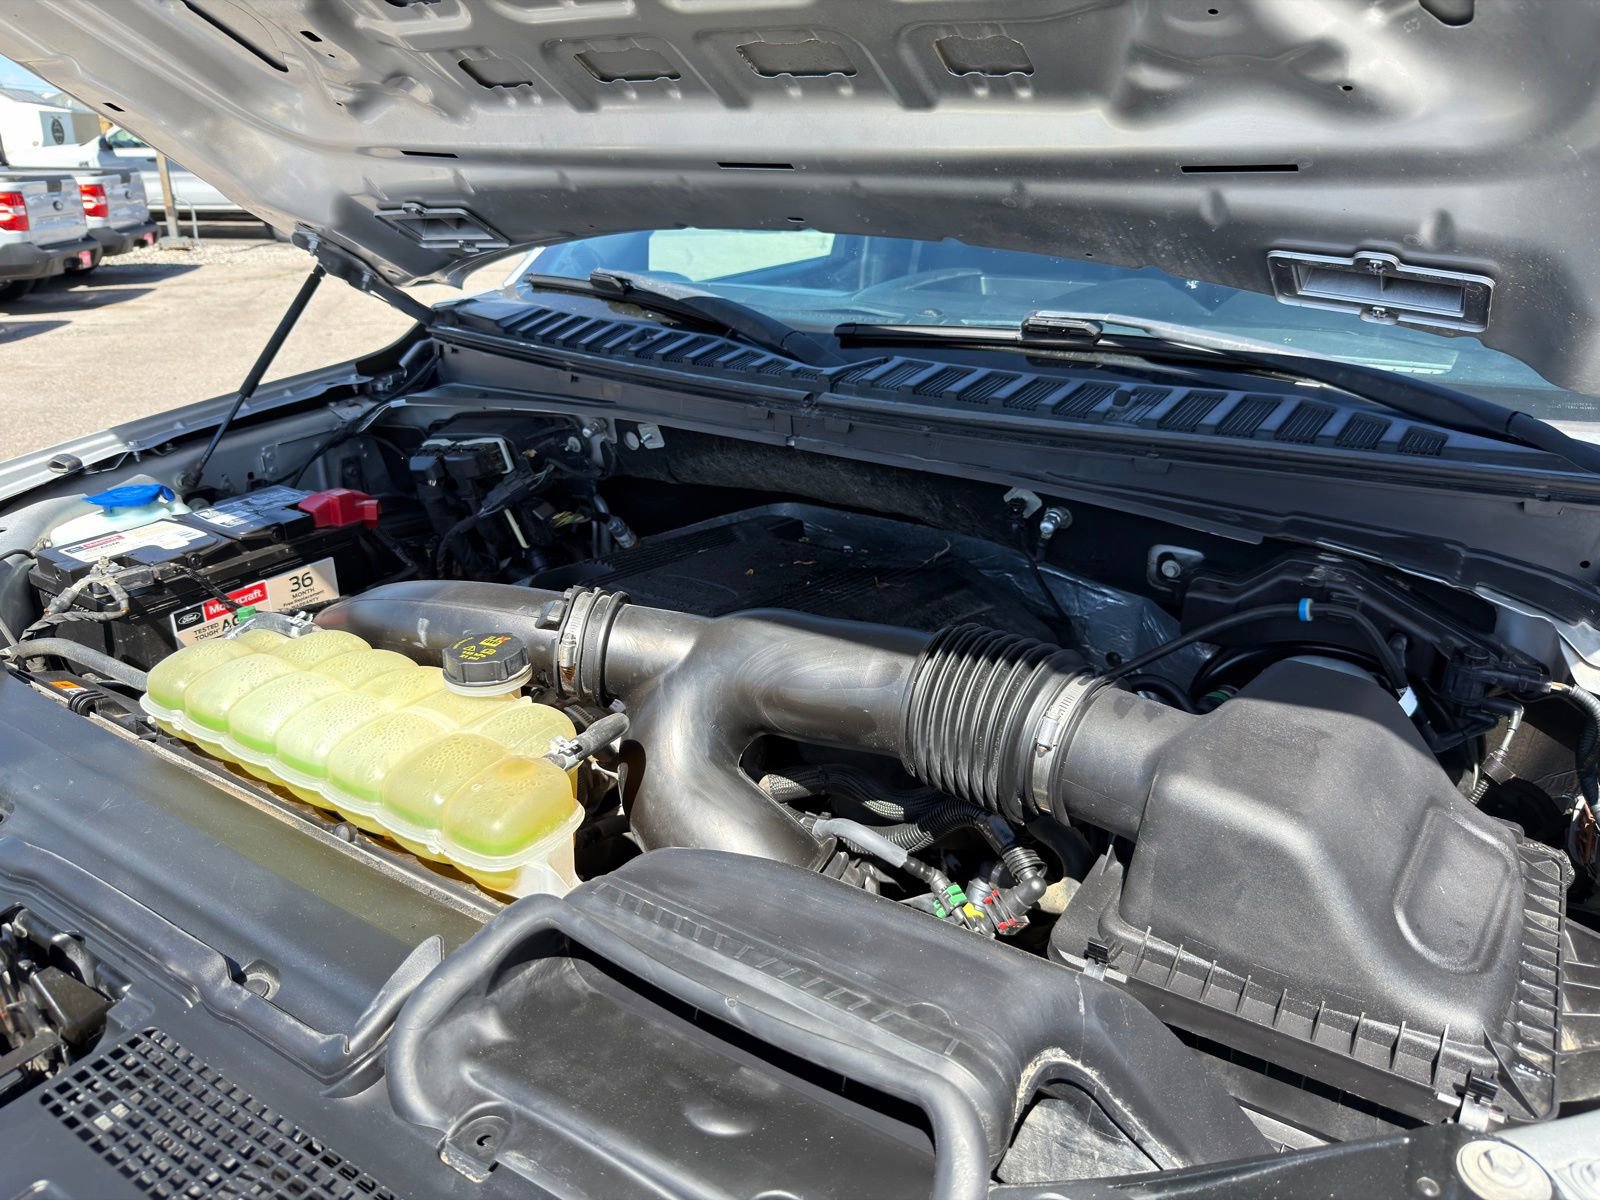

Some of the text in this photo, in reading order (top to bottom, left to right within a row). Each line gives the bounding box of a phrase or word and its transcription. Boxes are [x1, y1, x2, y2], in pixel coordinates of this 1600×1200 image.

[289, 571, 313, 592] 36
[292, 586, 315, 598] MONTH
[179, 589, 263, 624] Ford Morcraft
[194, 622, 219, 635] TESTED
[195, 628, 218, 641] TOUGH
